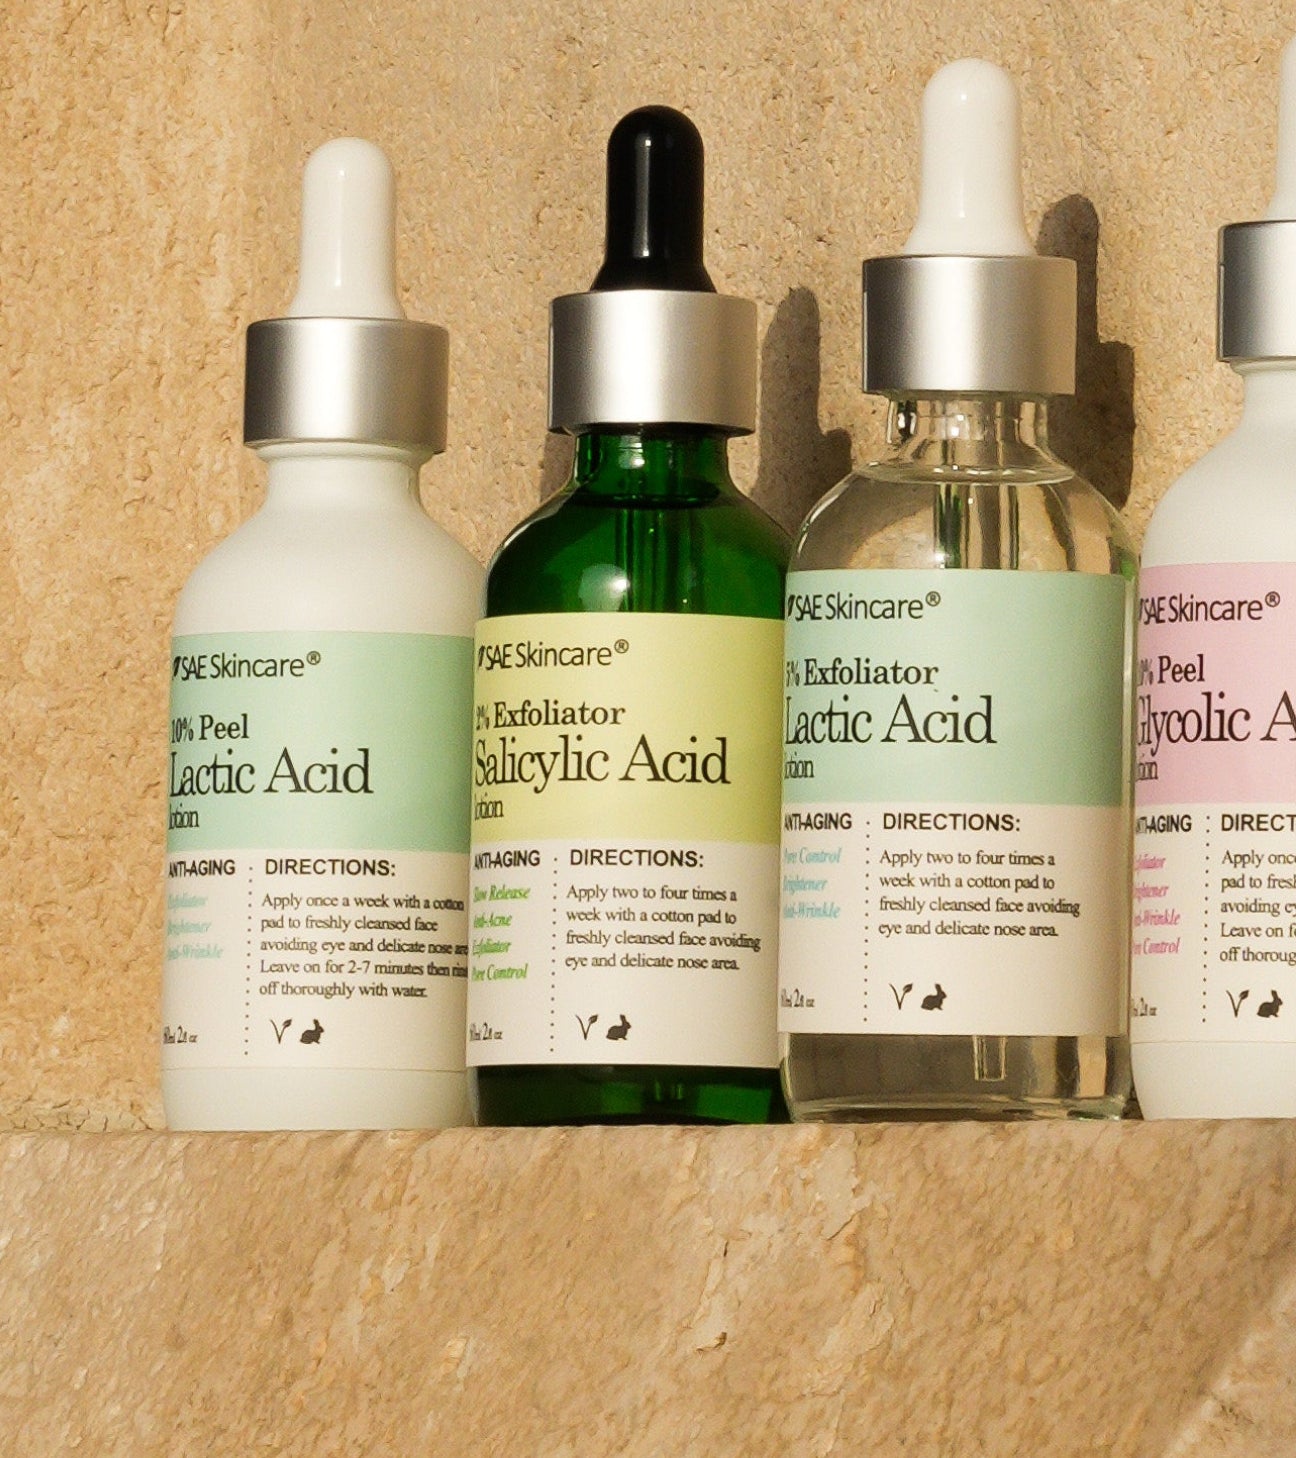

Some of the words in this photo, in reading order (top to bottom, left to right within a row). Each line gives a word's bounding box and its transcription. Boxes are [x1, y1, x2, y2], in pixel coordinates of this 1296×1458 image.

[795, 594, 822, 621] SAE
[1144, 597, 1166, 625] SAE
[486, 643, 512, 670] SAE
[182, 655, 207, 681] SAE
[804, 658, 939, 686] Exfoliator
[1158, 654, 1205, 684] Peel
[493, 700, 625, 728] Exfoliator
[785, 694, 872, 745] Lactic
[881, 693, 997, 744] Acid
[171, 716, 193, 743] 10%
[199, 713, 249, 741] Peel
[170, 748, 255, 797] Lactic
[264, 746, 374, 794] Acid
[475, 734, 609, 794] Salicylic
[619, 733, 731, 785] Acid
[784, 812, 852, 831] ANTI-AGING
[883, 813, 1021, 832] DIRECTIONS:
[474, 850, 540, 870] ANTI-AGING
[570, 850, 704, 867] DIRECTIONS:
[800, 847, 842, 865] Control
[880, 849, 923, 869] Apply
[927, 852, 953, 864] two
[958, 853, 971, 865] to
[976, 851, 1004, 865] four
[1009, 853, 1045, 866] times
[1047, 856, 1055, 866] a
[168, 860, 236, 878] ANTI-AGING
[265, 859, 396, 877] DIRECTIONS:
[1221, 874, 1245, 892] pad
[1249, 875, 1262, 888] to
[262, 893, 302, 911] Apply
[307, 896, 339, 907] once
[342, 898, 350, 907] a
[354, 894, 389, 907] week
[394, 894, 420, 909] with
[424, 899, 430, 910] a
[433, 897, 464, 911] cotton
[489, 885, 531, 901] Release
[566, 885, 608, 903] Apply
[612, 887, 638, 899] two
[643, 888, 656, 900] to
[660, 885, 689, 900] four
[693, 887, 727, 902] times
[729, 891, 737, 902] a
[879, 896, 925, 915] freshly
[929, 898, 991, 912] cleansed
[995, 898, 1023, 913] face
[1027, 899, 1080, 917] avoiding
[1220, 899, 1280, 917] avoiding
[566, 910, 601, 922] week
[606, 909, 636, 922] with
[640, 912, 648, 922] a
[652, 910, 694, 923] cotton
[697, 909, 721, 927] pad
[725, 912, 737, 925] to
[1220, 947, 1240, 962] off
[260, 960, 300, 973] Leave
[304, 963, 321, 973] on
[325, 960, 345, 974] for
[349, 961, 371, 974] 2-7
[375, 961, 425, 975] minutes
[427, 963, 450, 977] then
[487, 964, 529, 979] Control
[259, 981, 280, 995] off
[282, 983, 354, 999] thoroughly
[359, 983, 388, 997] with
[392, 985, 428, 998] water.
